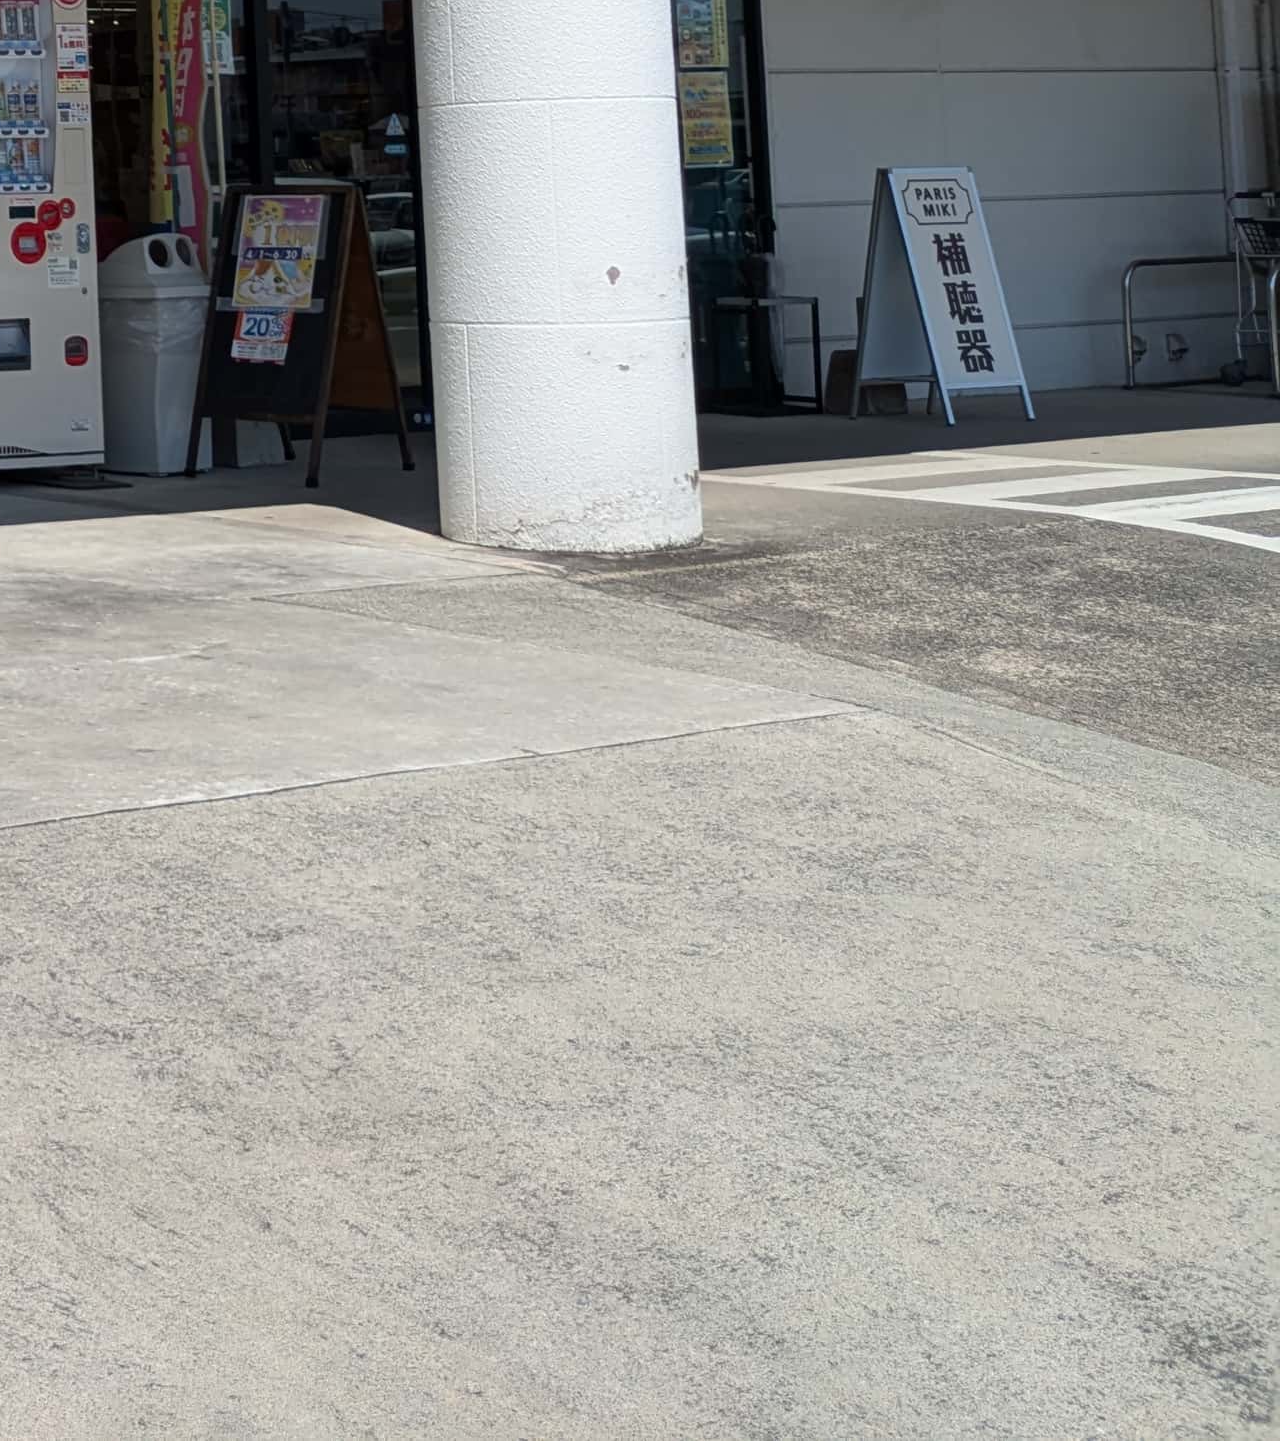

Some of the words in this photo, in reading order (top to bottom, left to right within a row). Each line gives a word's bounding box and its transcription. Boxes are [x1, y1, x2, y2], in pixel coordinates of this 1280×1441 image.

[913, 187, 958, 202] PARIS
[922, 203, 958, 218] MIKI
[932, 231, 996, 374] 補聴器
